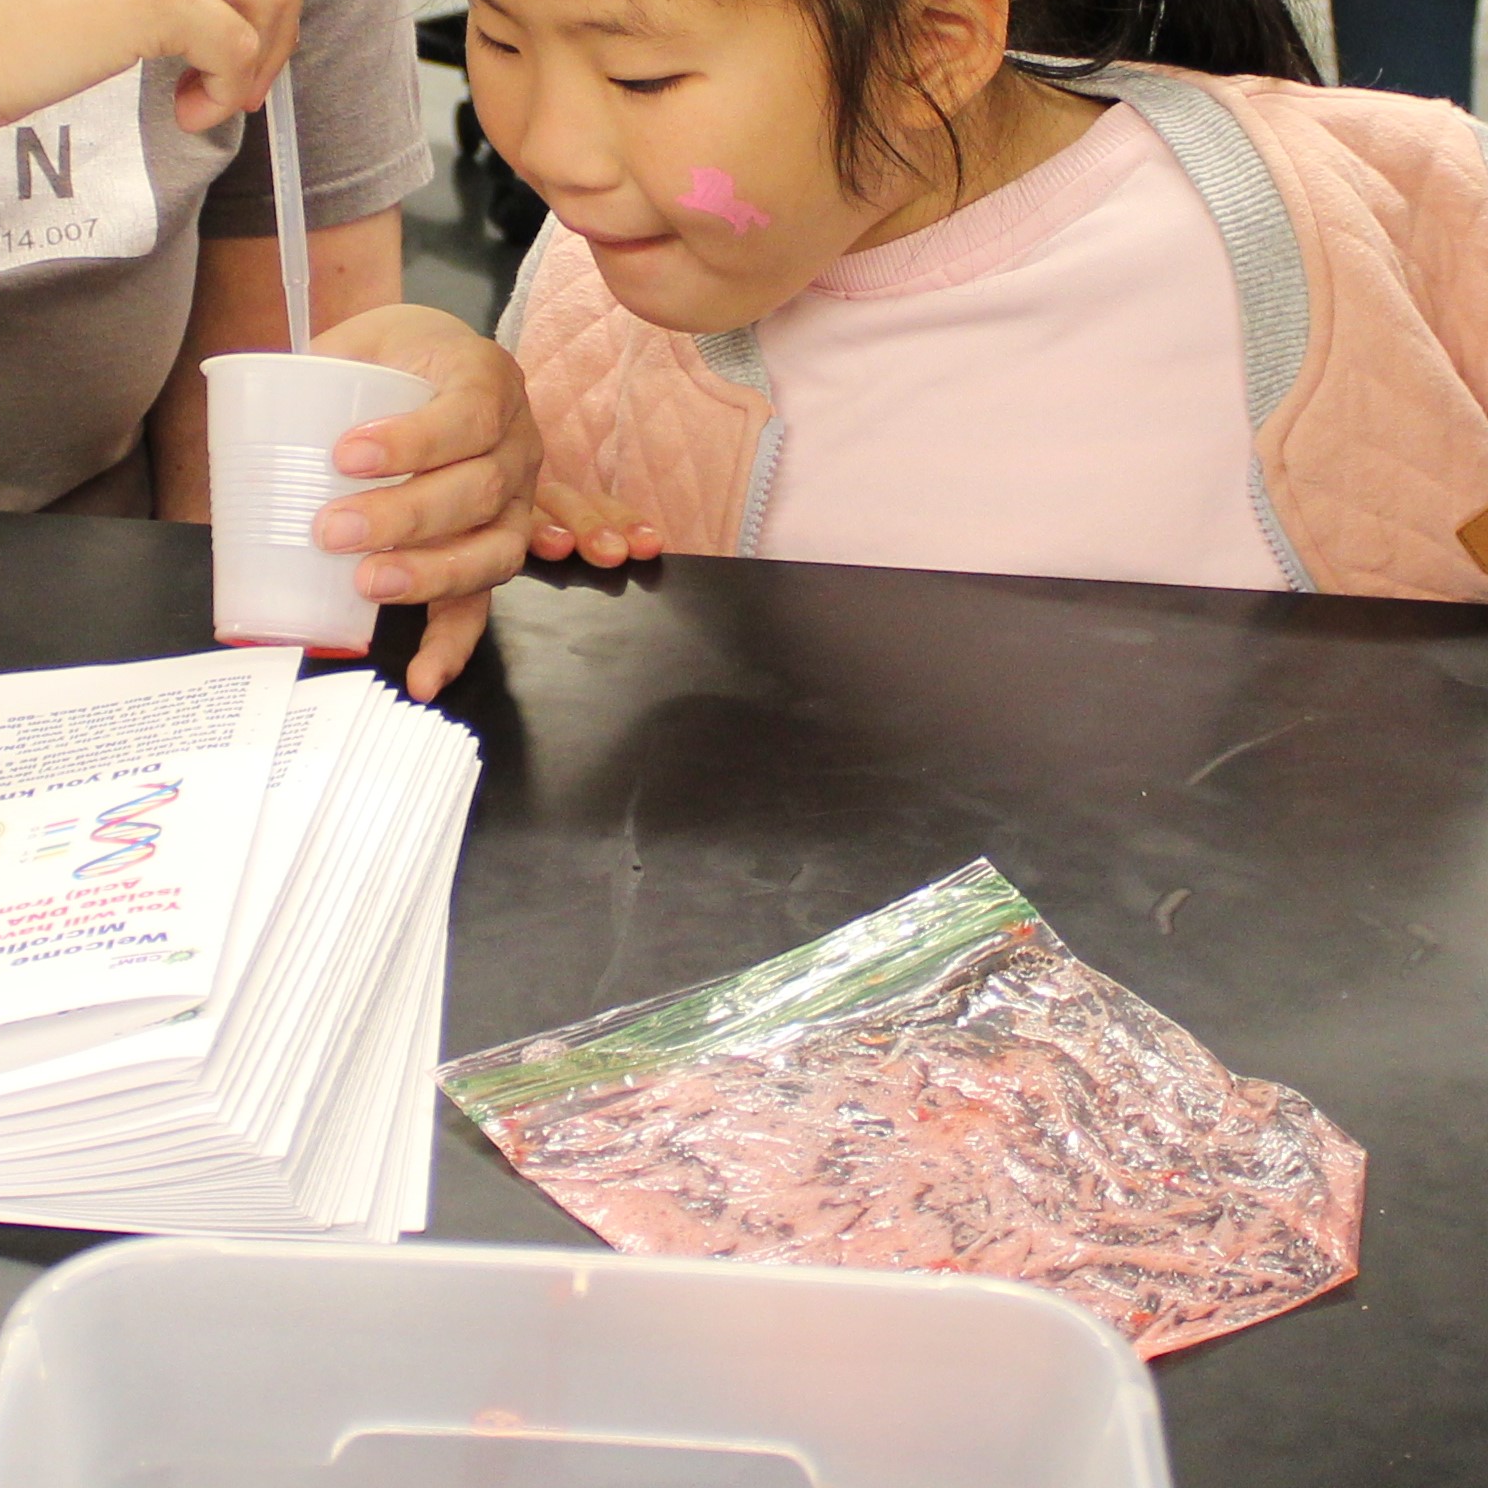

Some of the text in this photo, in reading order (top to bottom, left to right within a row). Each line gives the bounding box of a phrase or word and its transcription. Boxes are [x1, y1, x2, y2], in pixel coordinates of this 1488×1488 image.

[15, 124, 74, 201] N
[0, 218, 99, 254] 14.007
[45, 771, 102, 792] you
[111, 762, 161, 780] Did
[64, 877, 142, 901] Acid)
[79, 887, 181, 908] isolate
[7, 905, 68, 926] DNA
[127, 900, 180, 914] You
[63, 909, 115, 928] will
[10, 931, 168, 966] Welcome
